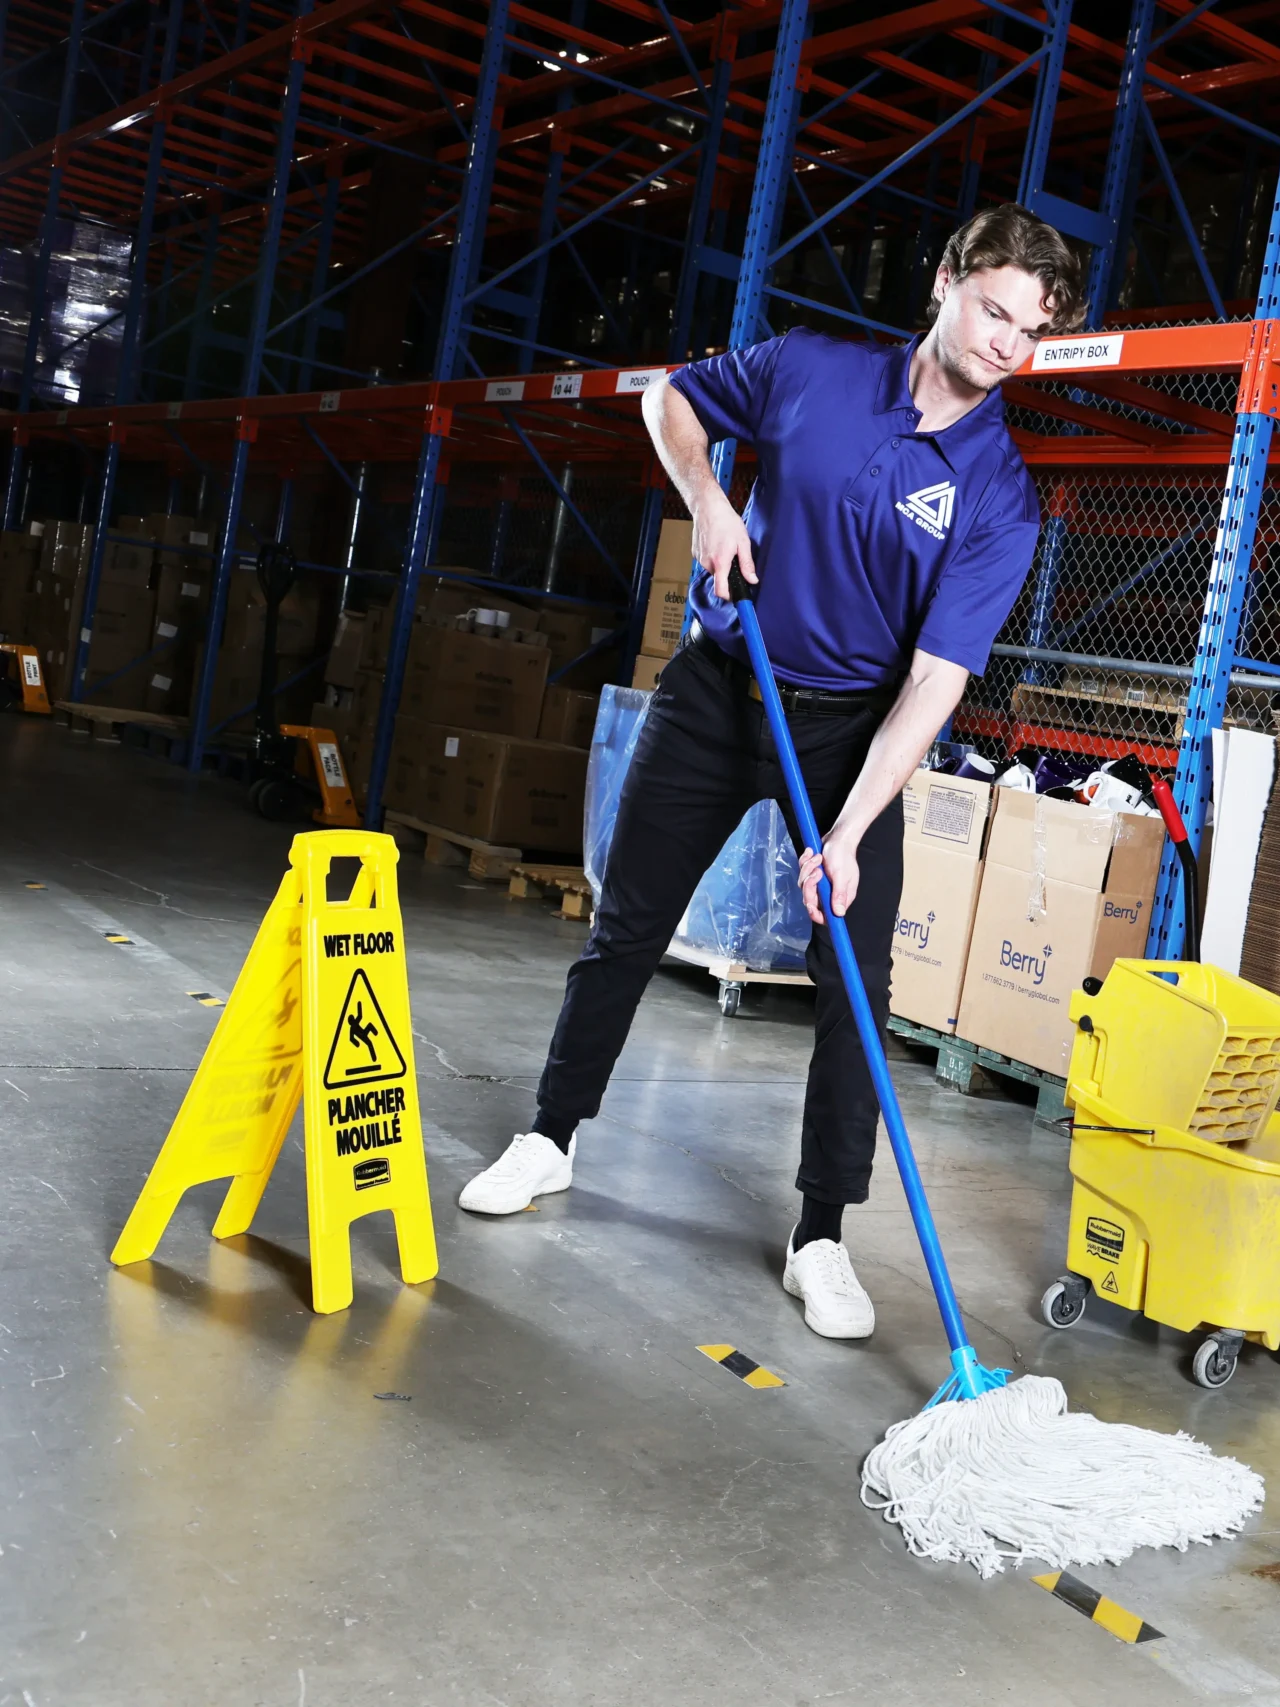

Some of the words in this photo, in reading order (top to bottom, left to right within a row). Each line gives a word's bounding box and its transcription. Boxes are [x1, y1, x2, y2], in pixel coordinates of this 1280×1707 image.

[1044, 347, 1085, 361] ENTRIPY
[1087, 345, 1109, 358] BOX
[630, 376, 650, 386] POUCH
[915, 517, 946, 540] GROUP
[1103, 901, 1138, 924] Berry
[323, 934, 351, 958] WET
[353, 931, 395, 955] FLOOR
[1000, 940, 1046, 985] Berry
[1018, 986, 1060, 1004] berryglobal.com
[328, 1087, 406, 1126] PLANCHER
[336, 1113, 402, 1157] MOUILLÉ
[1090, 1222, 1122, 1237] Rubbermaid
